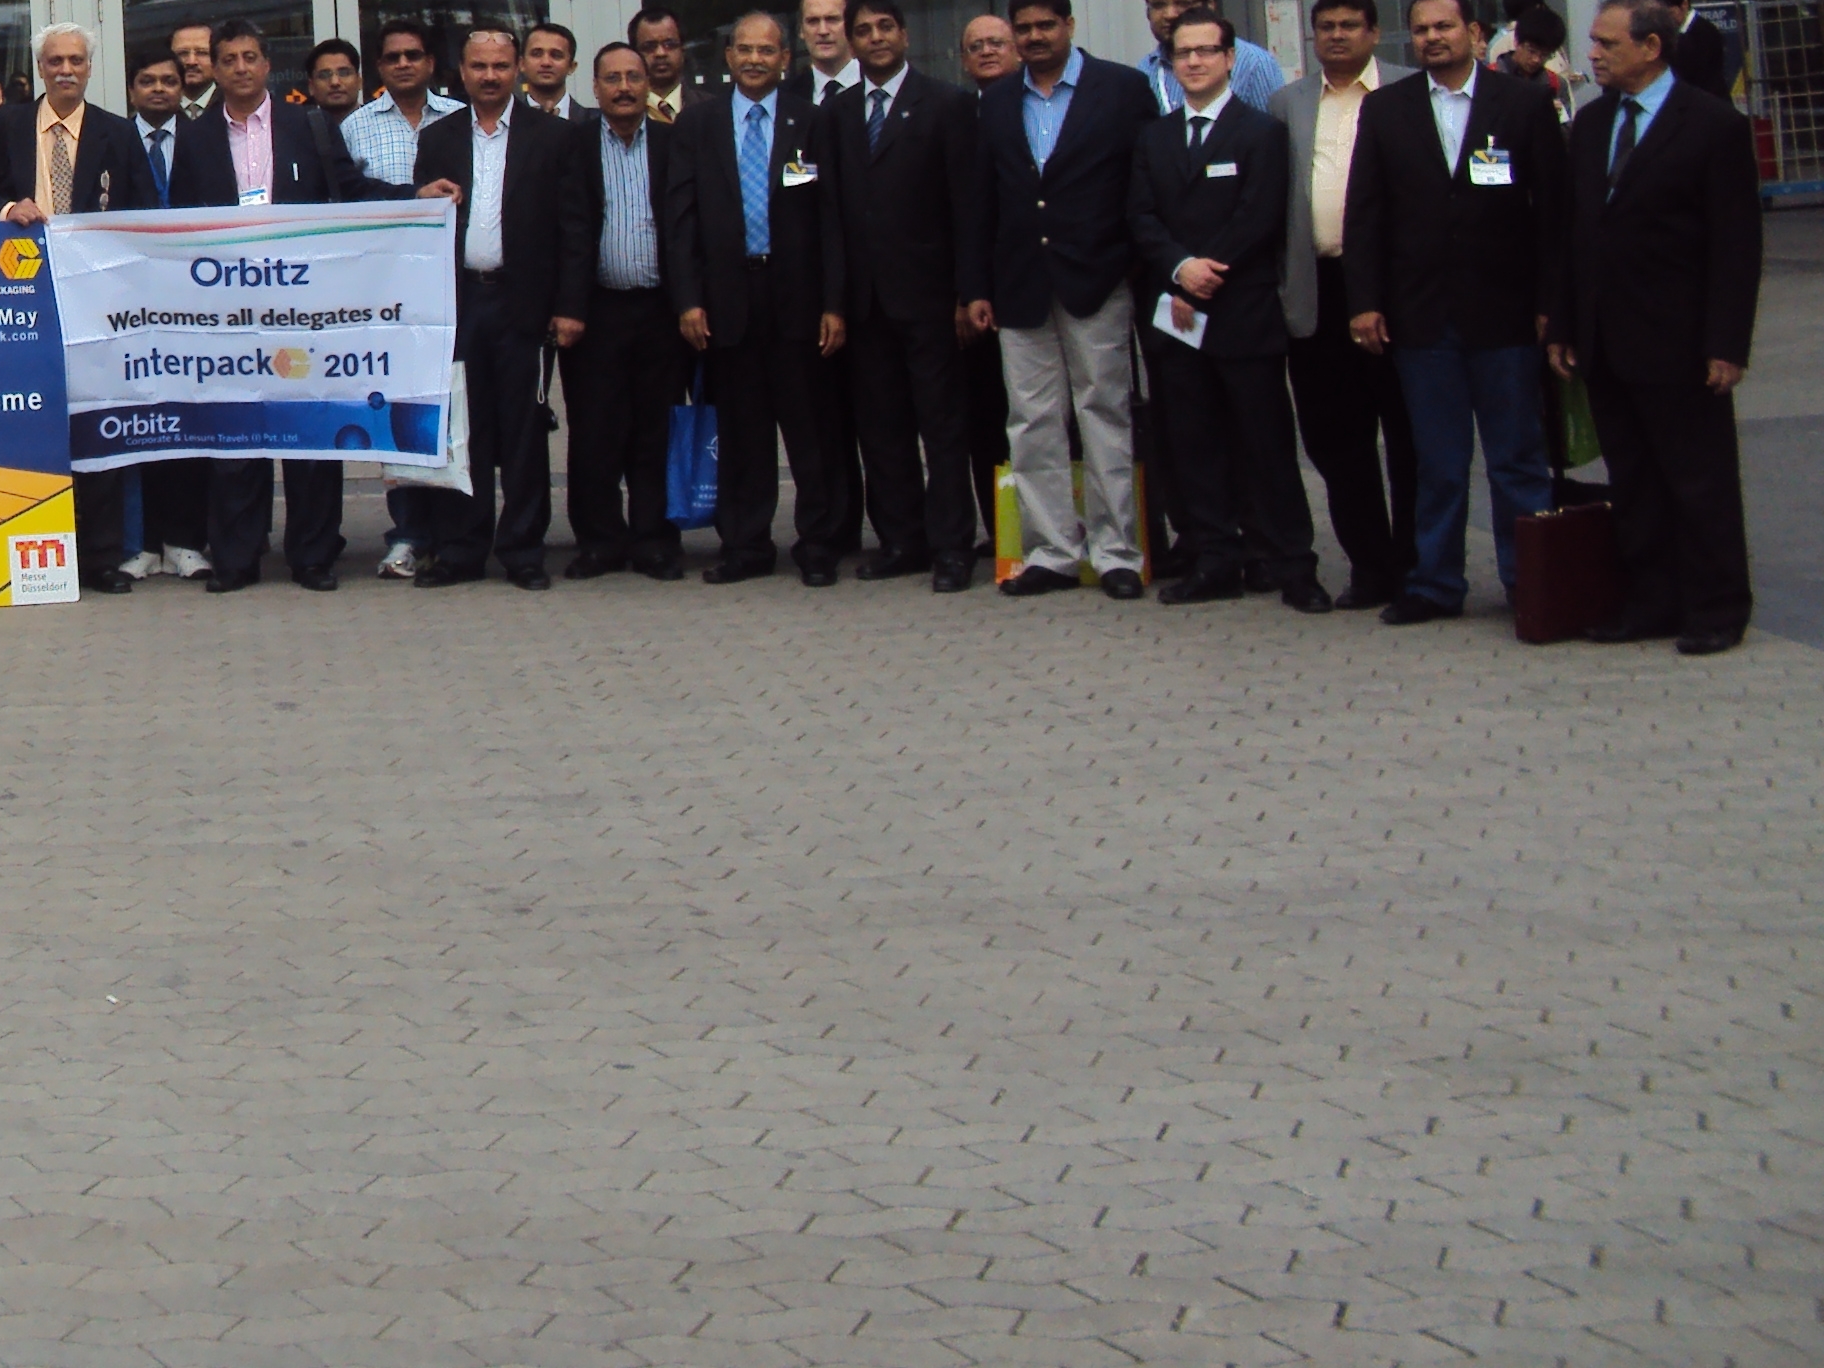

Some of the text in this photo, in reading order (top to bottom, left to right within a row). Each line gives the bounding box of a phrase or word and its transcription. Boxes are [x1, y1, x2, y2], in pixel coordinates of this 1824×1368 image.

[190, 257, 310, 287] Orbitz
[107, 303, 403, 331] Welcomes all delegates of
[124, 348, 390, 383] interpack 2011
[99, 413, 181, 439] Orbitz
[126, 434, 171, 446] Corporate
[174, 434, 182, 442] &
[184, 434, 216, 442] Leisure
[218, 434, 249, 443] Travels
[21, 573, 47, 581] Messe
[22, 581, 67, 593] Düsseldorf
